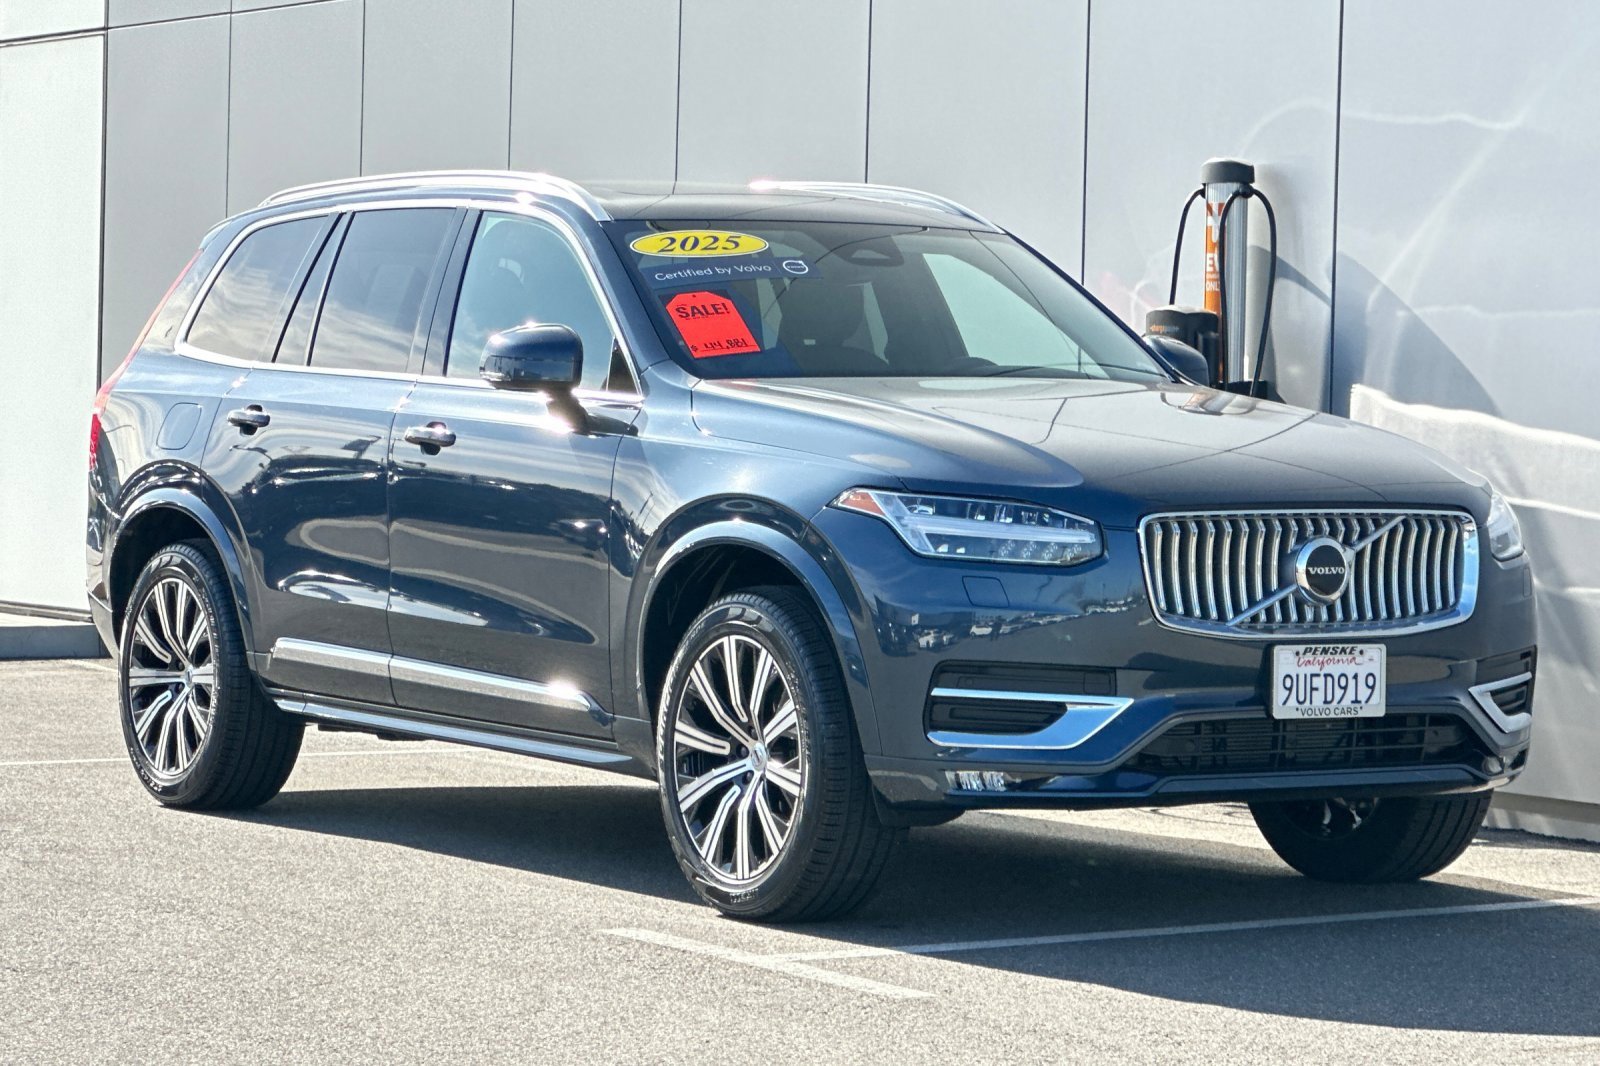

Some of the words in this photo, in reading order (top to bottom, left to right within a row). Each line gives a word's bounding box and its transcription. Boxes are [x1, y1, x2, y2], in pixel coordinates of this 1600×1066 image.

[656, 235, 742, 253] 2025
[654, 267, 713, 281] Certified
[714, 266, 732, 275] by
[733, 264, 772, 273] Volvo
[1206, 281, 1220, 291] ONL
[675, 302, 730, 318] SALE!
[1308, 567, 1345, 575] VOLVO
[1302, 646, 1358, 656] PENSKE
[1296, 656, 1364, 671] California
[1281, 672, 1377, 706] 9UFD919
[1300, 707, 1331, 717] VOLVO
[1333, 706, 1359, 716] CARS
